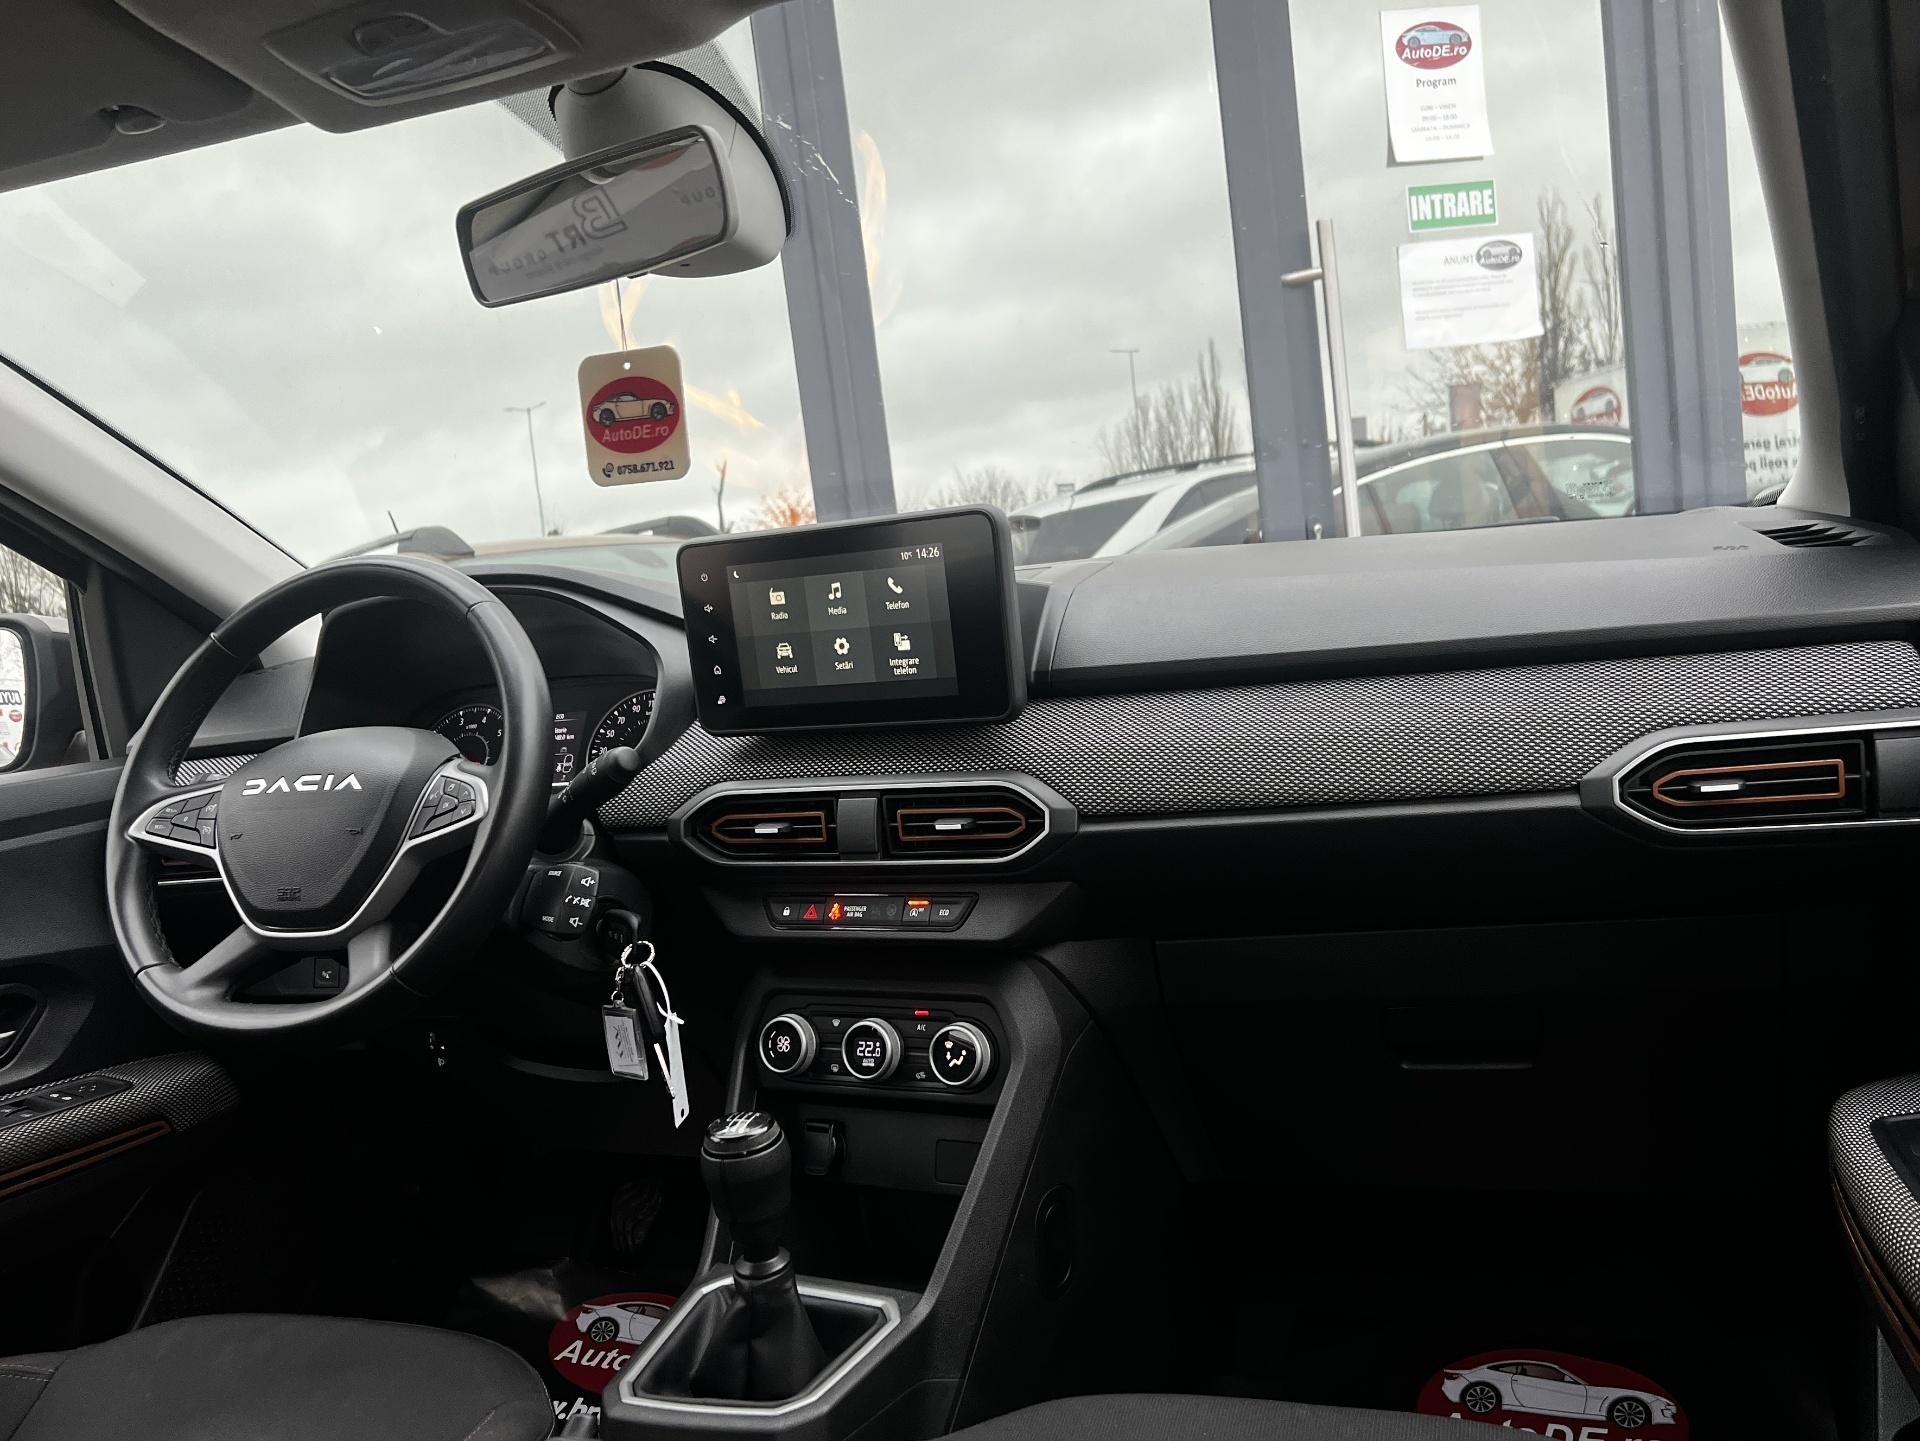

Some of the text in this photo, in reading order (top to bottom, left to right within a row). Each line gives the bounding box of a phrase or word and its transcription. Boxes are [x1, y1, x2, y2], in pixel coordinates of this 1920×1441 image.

[1401, 45, 1468, 60] AutoDE.ro
[1416, 77, 1457, 89] Program
[1410, 189, 1494, 221] INTRARE
[602, 424, 670, 443] AutoDE.ro
[617, 460, 675, 475] 0758.671.921
[916, 547, 940, 560] 14:26
[828, 605, 847, 615] Media
[885, 600, 910, 610] Telefon
[771, 611, 789, 620] Radio
[889, 657, 920, 668] Integrare
[776, 665, 798, 674] Vehicul
[893, 666, 917, 675] telefon
[632, 705, 641, 713] 90
[458, 717, 465, 726] 3
[481, 716, 487, 724] 4
[617, 716, 626, 725] 70
[497, 729, 503, 737] 5
[605, 729, 615, 738] 50
[242, 773, 363, 796] DACIA
